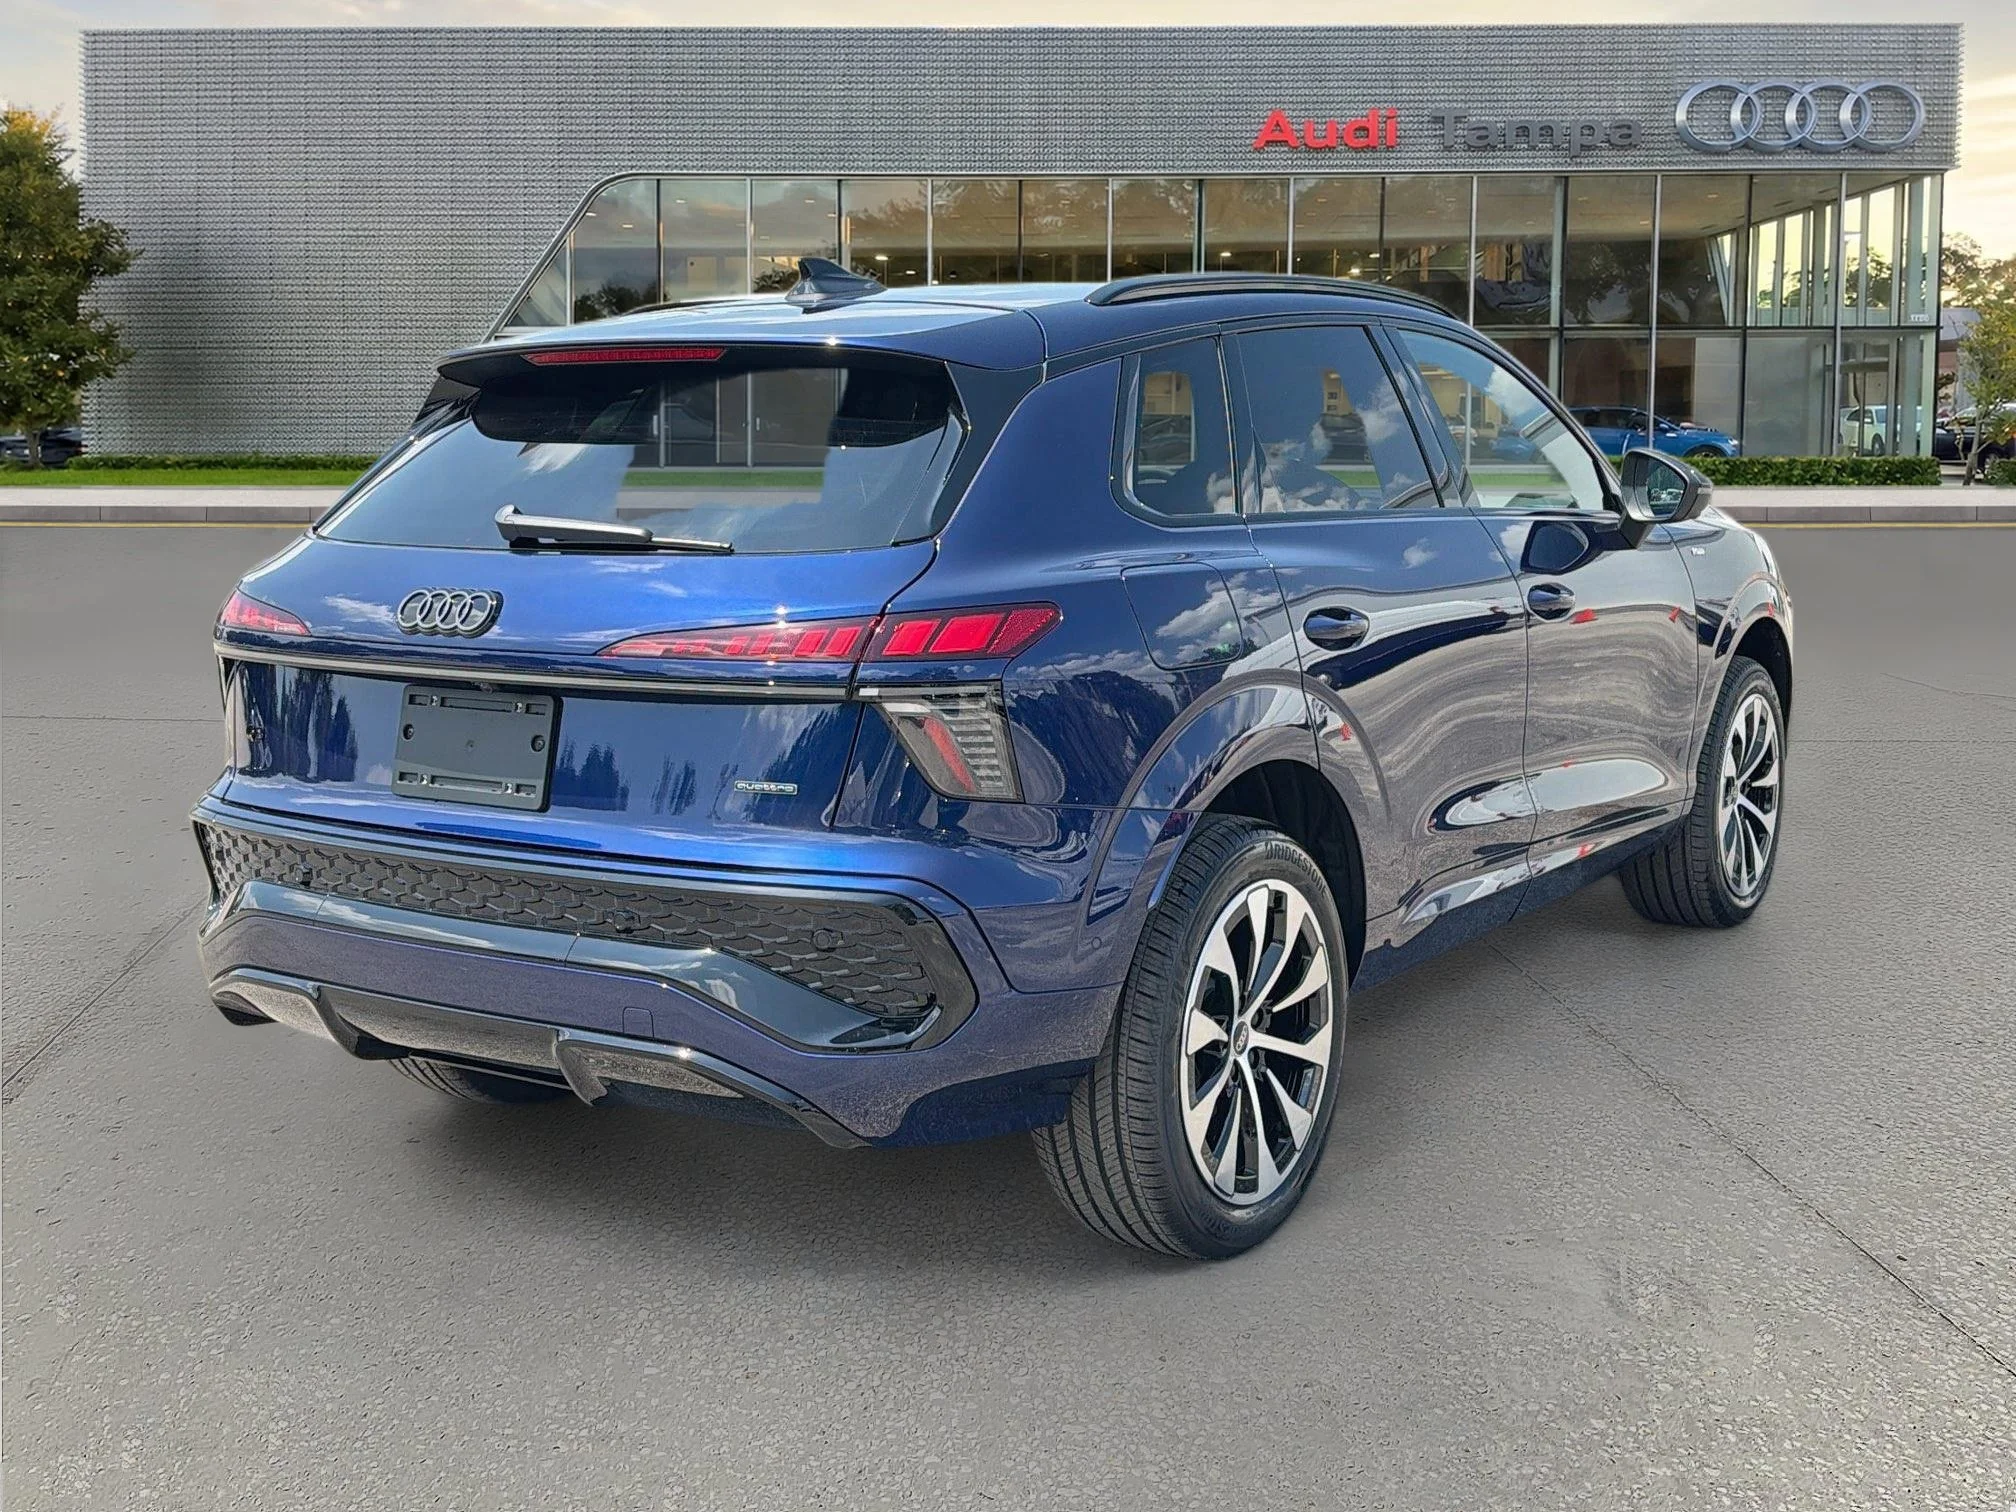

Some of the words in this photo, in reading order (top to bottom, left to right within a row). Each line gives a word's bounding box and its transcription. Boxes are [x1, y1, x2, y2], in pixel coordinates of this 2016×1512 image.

[1253, 107, 1398, 149] Audi
[1431, 107, 1643, 157] Tampa
[735, 782, 796, 793] quattro
